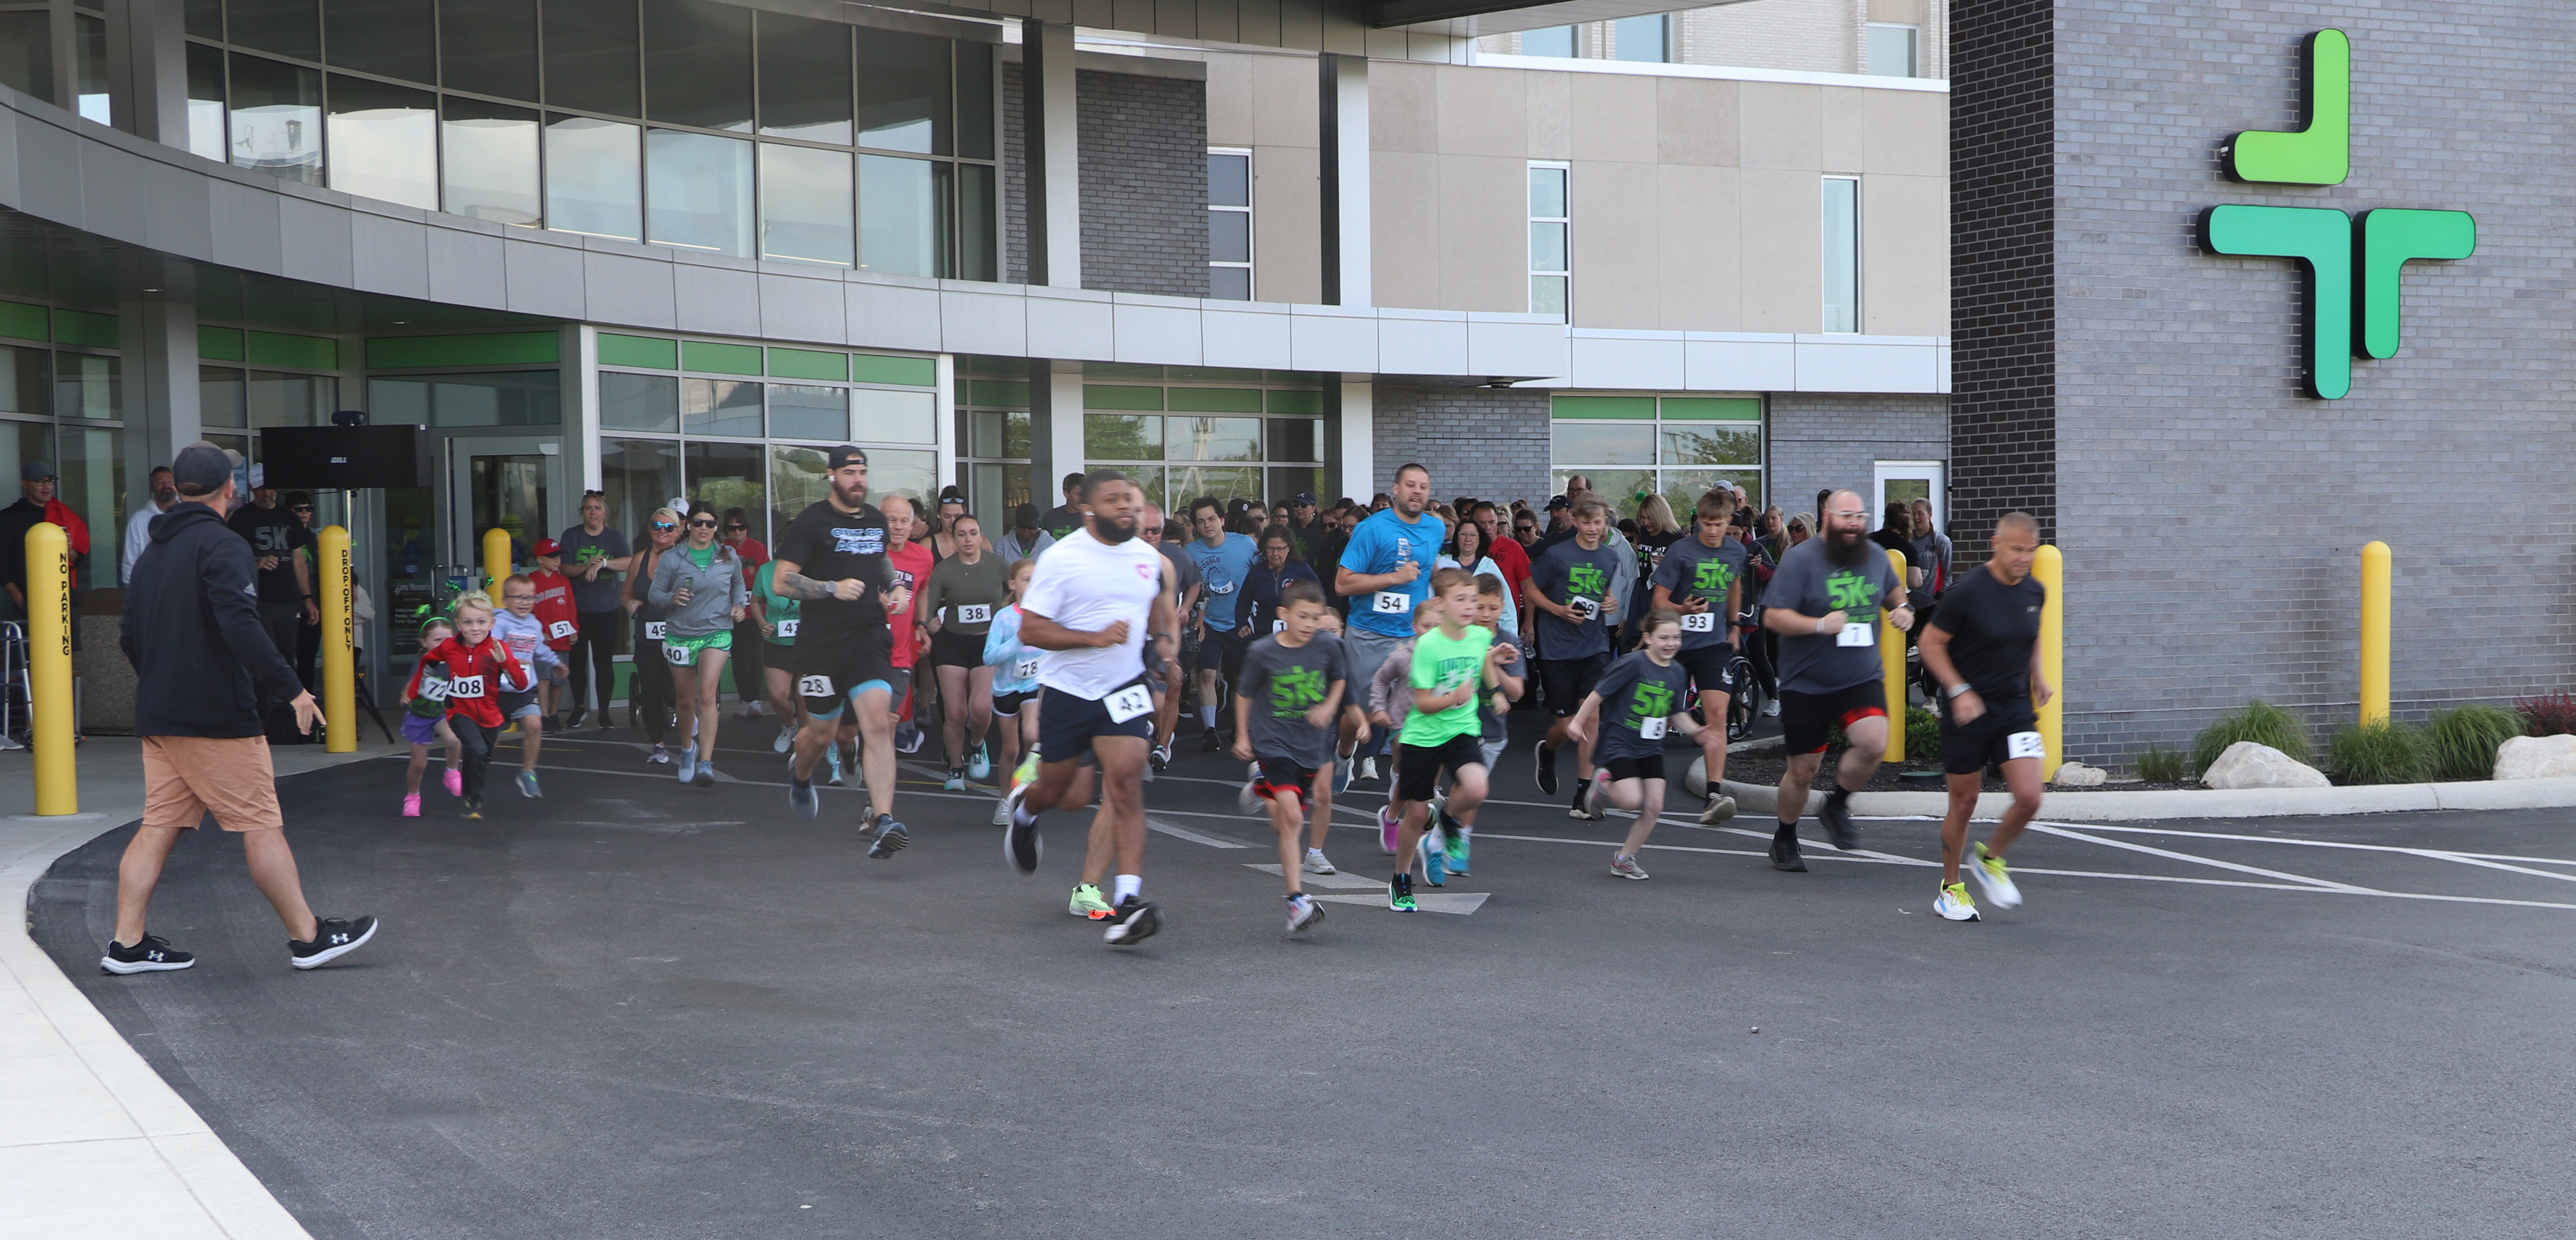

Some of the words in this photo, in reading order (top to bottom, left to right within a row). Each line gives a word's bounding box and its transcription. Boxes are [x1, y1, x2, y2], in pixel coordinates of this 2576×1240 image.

[255, 526, 289, 550] 5K
[60, 553, 67, 574] NO
[1567, 567, 1604, 595] 5K
[1693, 562, 1730, 590] 5K
[1825, 575, 1872, 610] 5K
[1381, 596, 1402, 611] 54
[61, 581, 69, 655] PARKING
[965, 608, 984, 620] 38
[1688, 615, 1706, 628] 93
[557, 623, 569, 635] 57
[651, 625, 666, 637] 49
[784, 623, 800, 634] 41
[1851, 626, 1859, 643] 7
[666, 647, 682, 662] 40
[1021, 661, 1038, 677] 78
[428, 680, 447, 698] 72
[449, 679, 481, 695] 108
[802, 679, 824, 693] 28
[1270, 670, 1325, 708] 5K
[1118, 691, 1145, 713] 42
[1630, 682, 1674, 718] 5K
